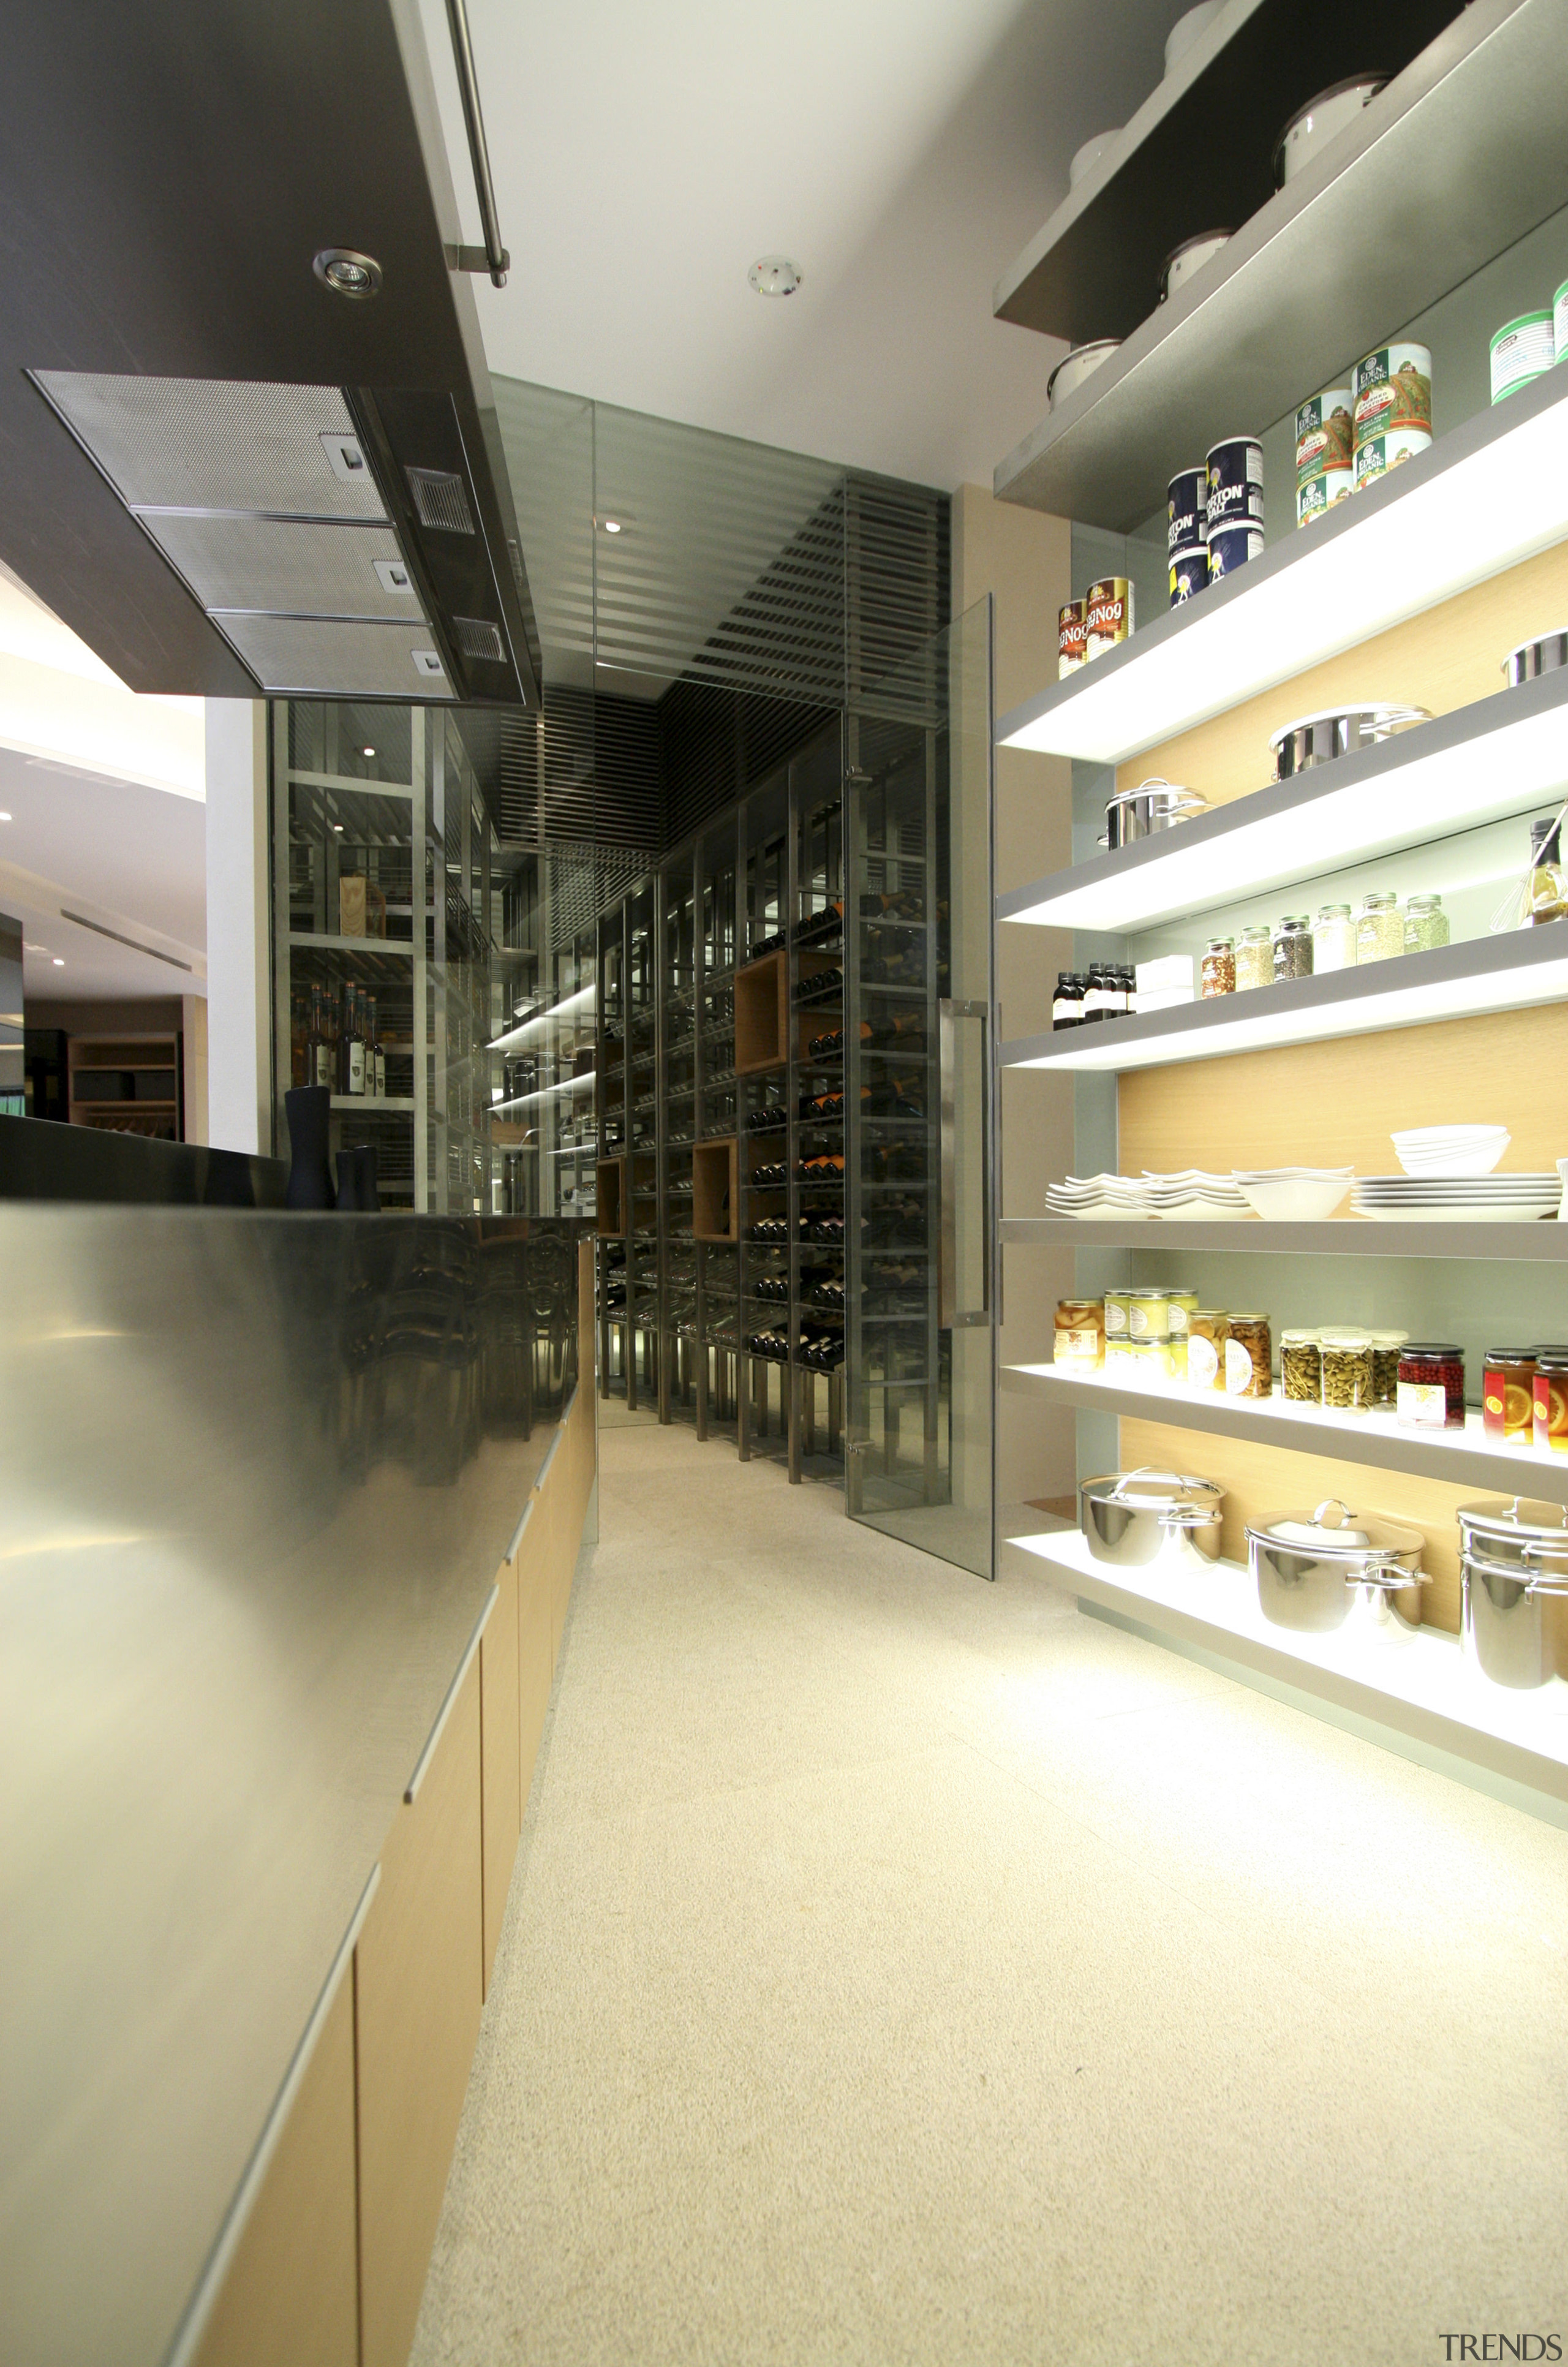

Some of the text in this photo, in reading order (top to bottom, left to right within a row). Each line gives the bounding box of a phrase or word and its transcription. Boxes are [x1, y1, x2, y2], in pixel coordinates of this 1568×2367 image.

[1358, 371, 1387, 393] ORGANIC
[1360, 364, 1383, 383] EDEN
[1297, 418, 1321, 437] ORGANIC
[1298, 412, 1317, 429] EDEN
[1357, 458, 1384, 479] ORGANIC
[1359, 451, 1380, 471] EDEN
[1206, 484, 1243, 512] ORTON
[1302, 490, 1322, 508] EDEN
[1169, 531, 1179, 550] ALT
